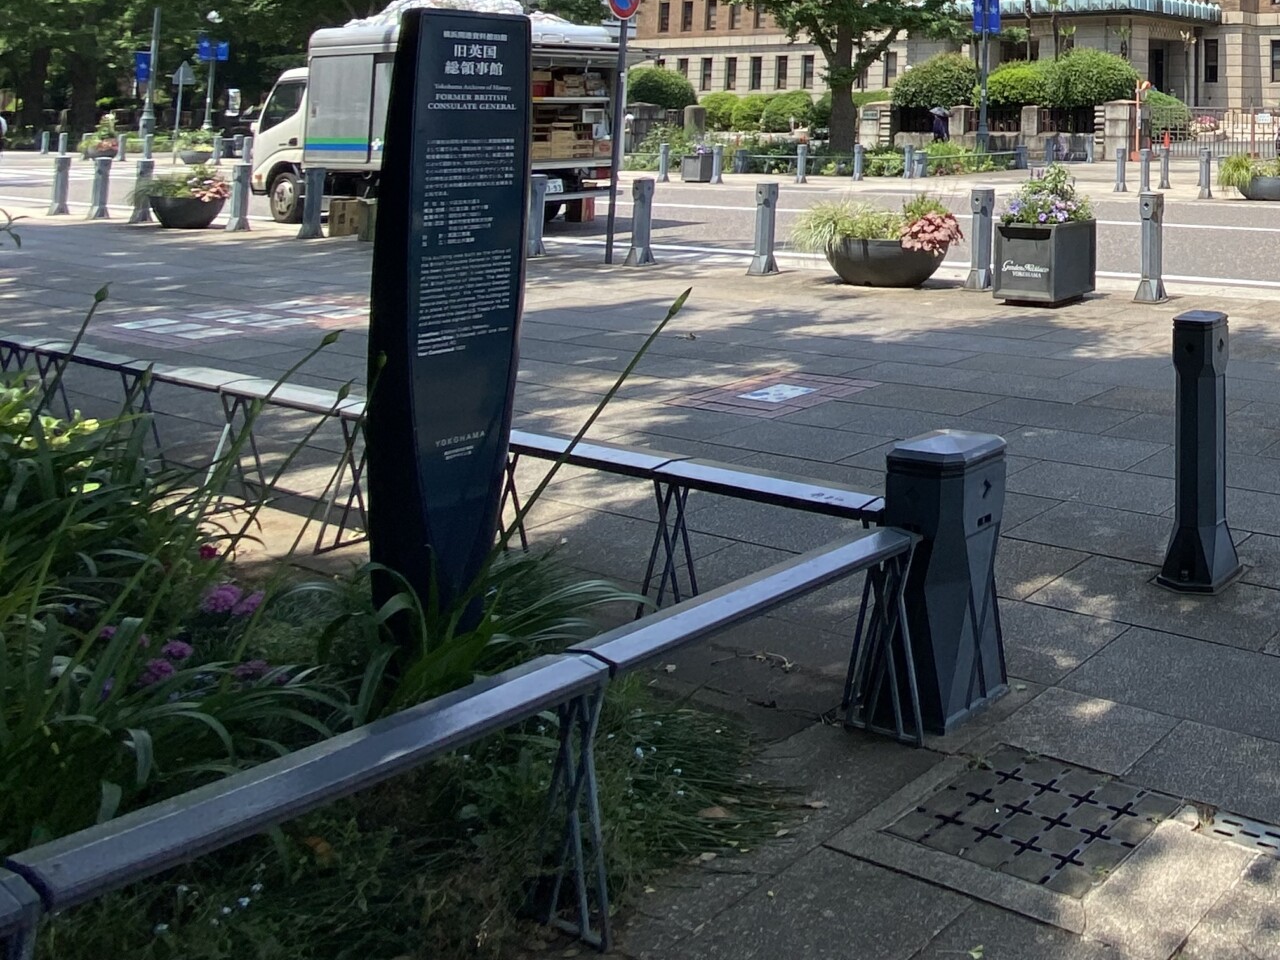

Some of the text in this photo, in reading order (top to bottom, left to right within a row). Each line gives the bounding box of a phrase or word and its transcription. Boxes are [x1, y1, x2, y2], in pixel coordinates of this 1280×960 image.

[453, 44, 497, 59] 旧英国
[444, 60, 504, 76] 総領事館
[435, 430, 485, 447] YOKOHAMA
